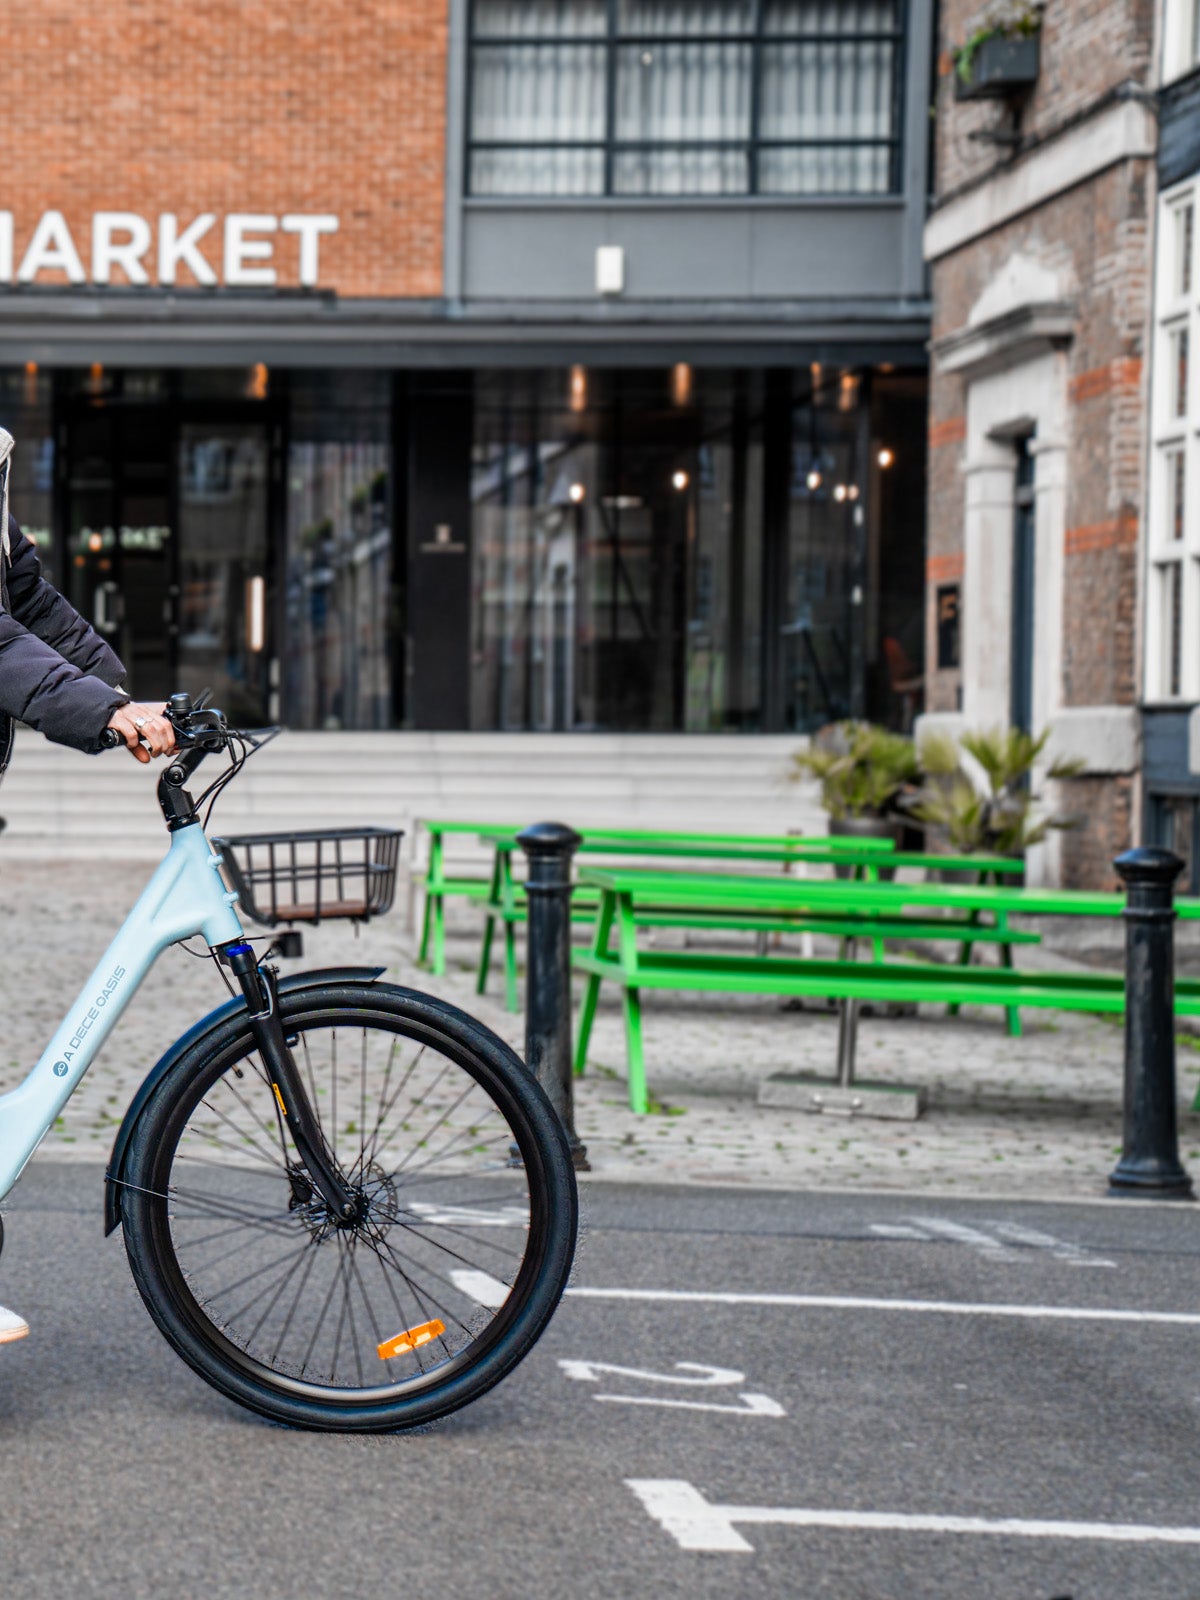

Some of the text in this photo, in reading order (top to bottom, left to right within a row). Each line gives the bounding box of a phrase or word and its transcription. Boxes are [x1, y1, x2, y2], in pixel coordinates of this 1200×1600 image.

[63, 1050, 75, 1062] A
[69, 1006, 100, 1050] DECE
[95, 965, 126, 1007] OASIS
